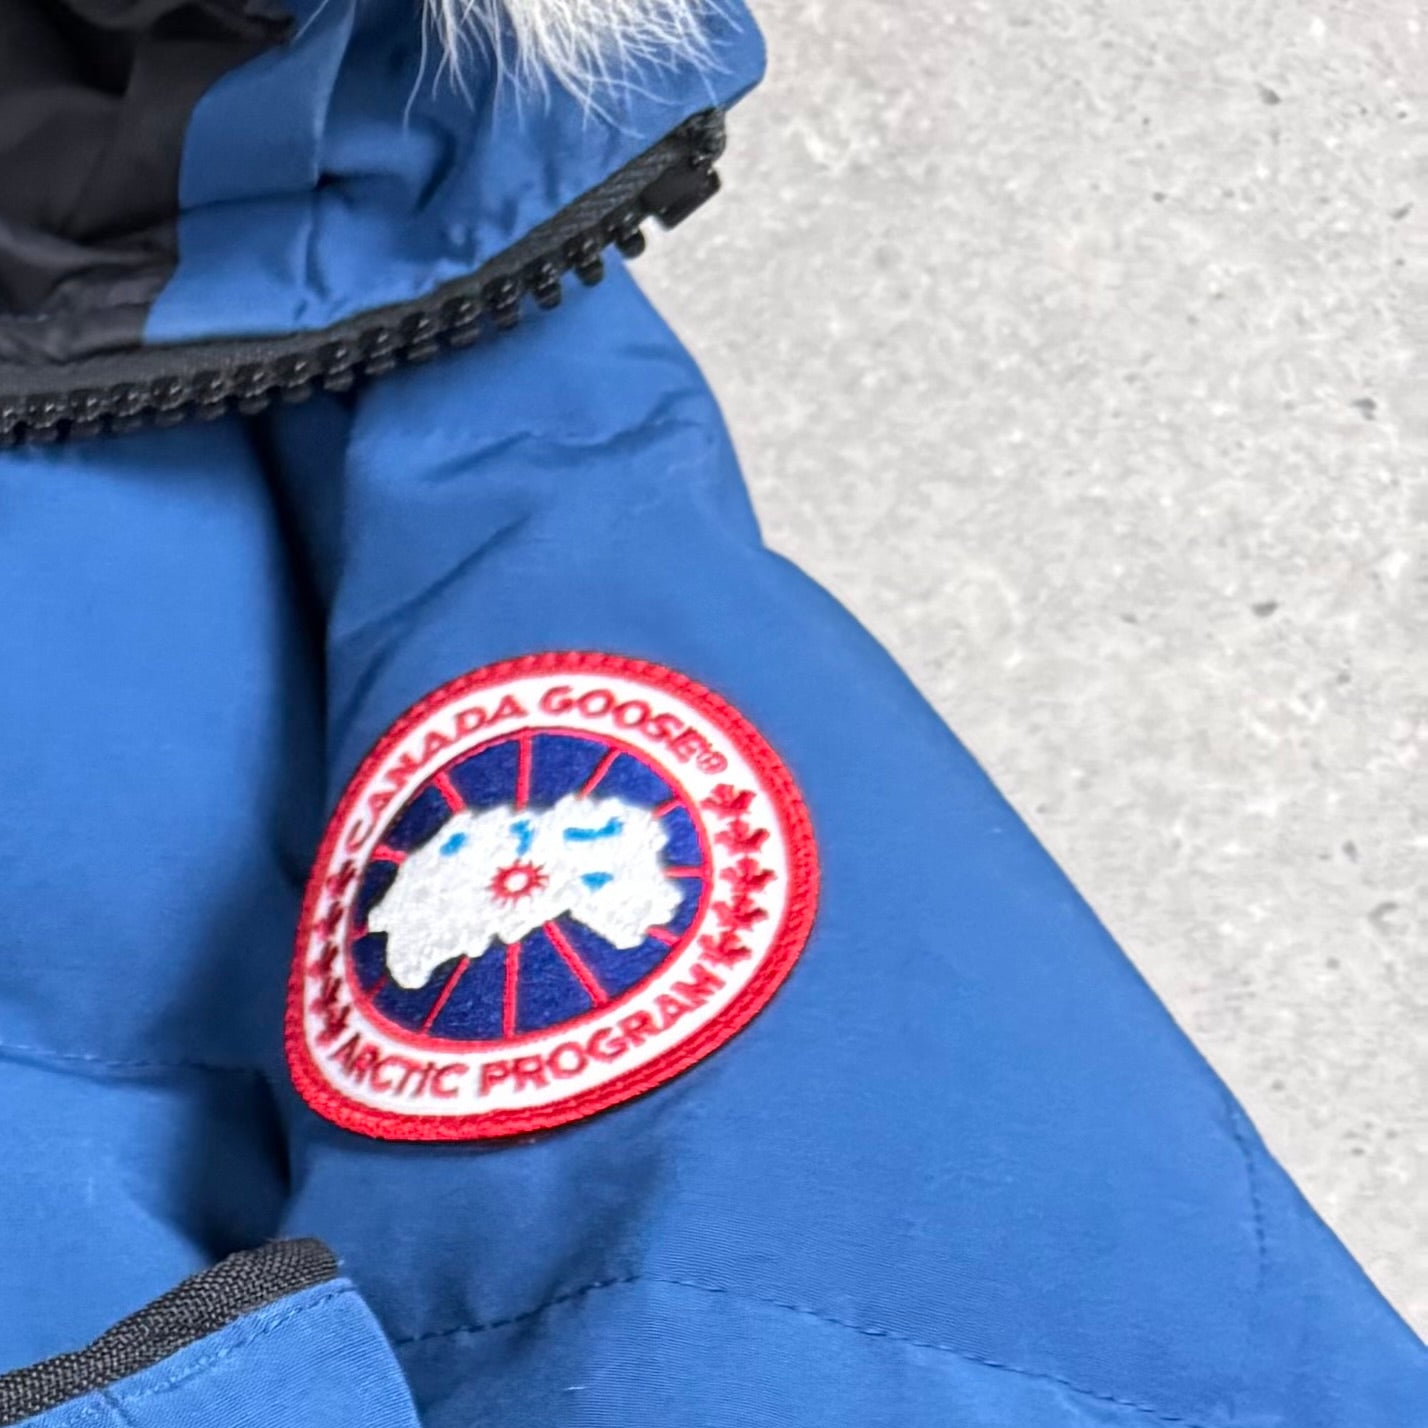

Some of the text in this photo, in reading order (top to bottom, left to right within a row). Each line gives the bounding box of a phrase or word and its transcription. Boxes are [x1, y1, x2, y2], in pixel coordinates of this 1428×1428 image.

[345, 694, 529, 854] CANADA
[330, 962, 726, 1099] ARCTIC PROGRAM
